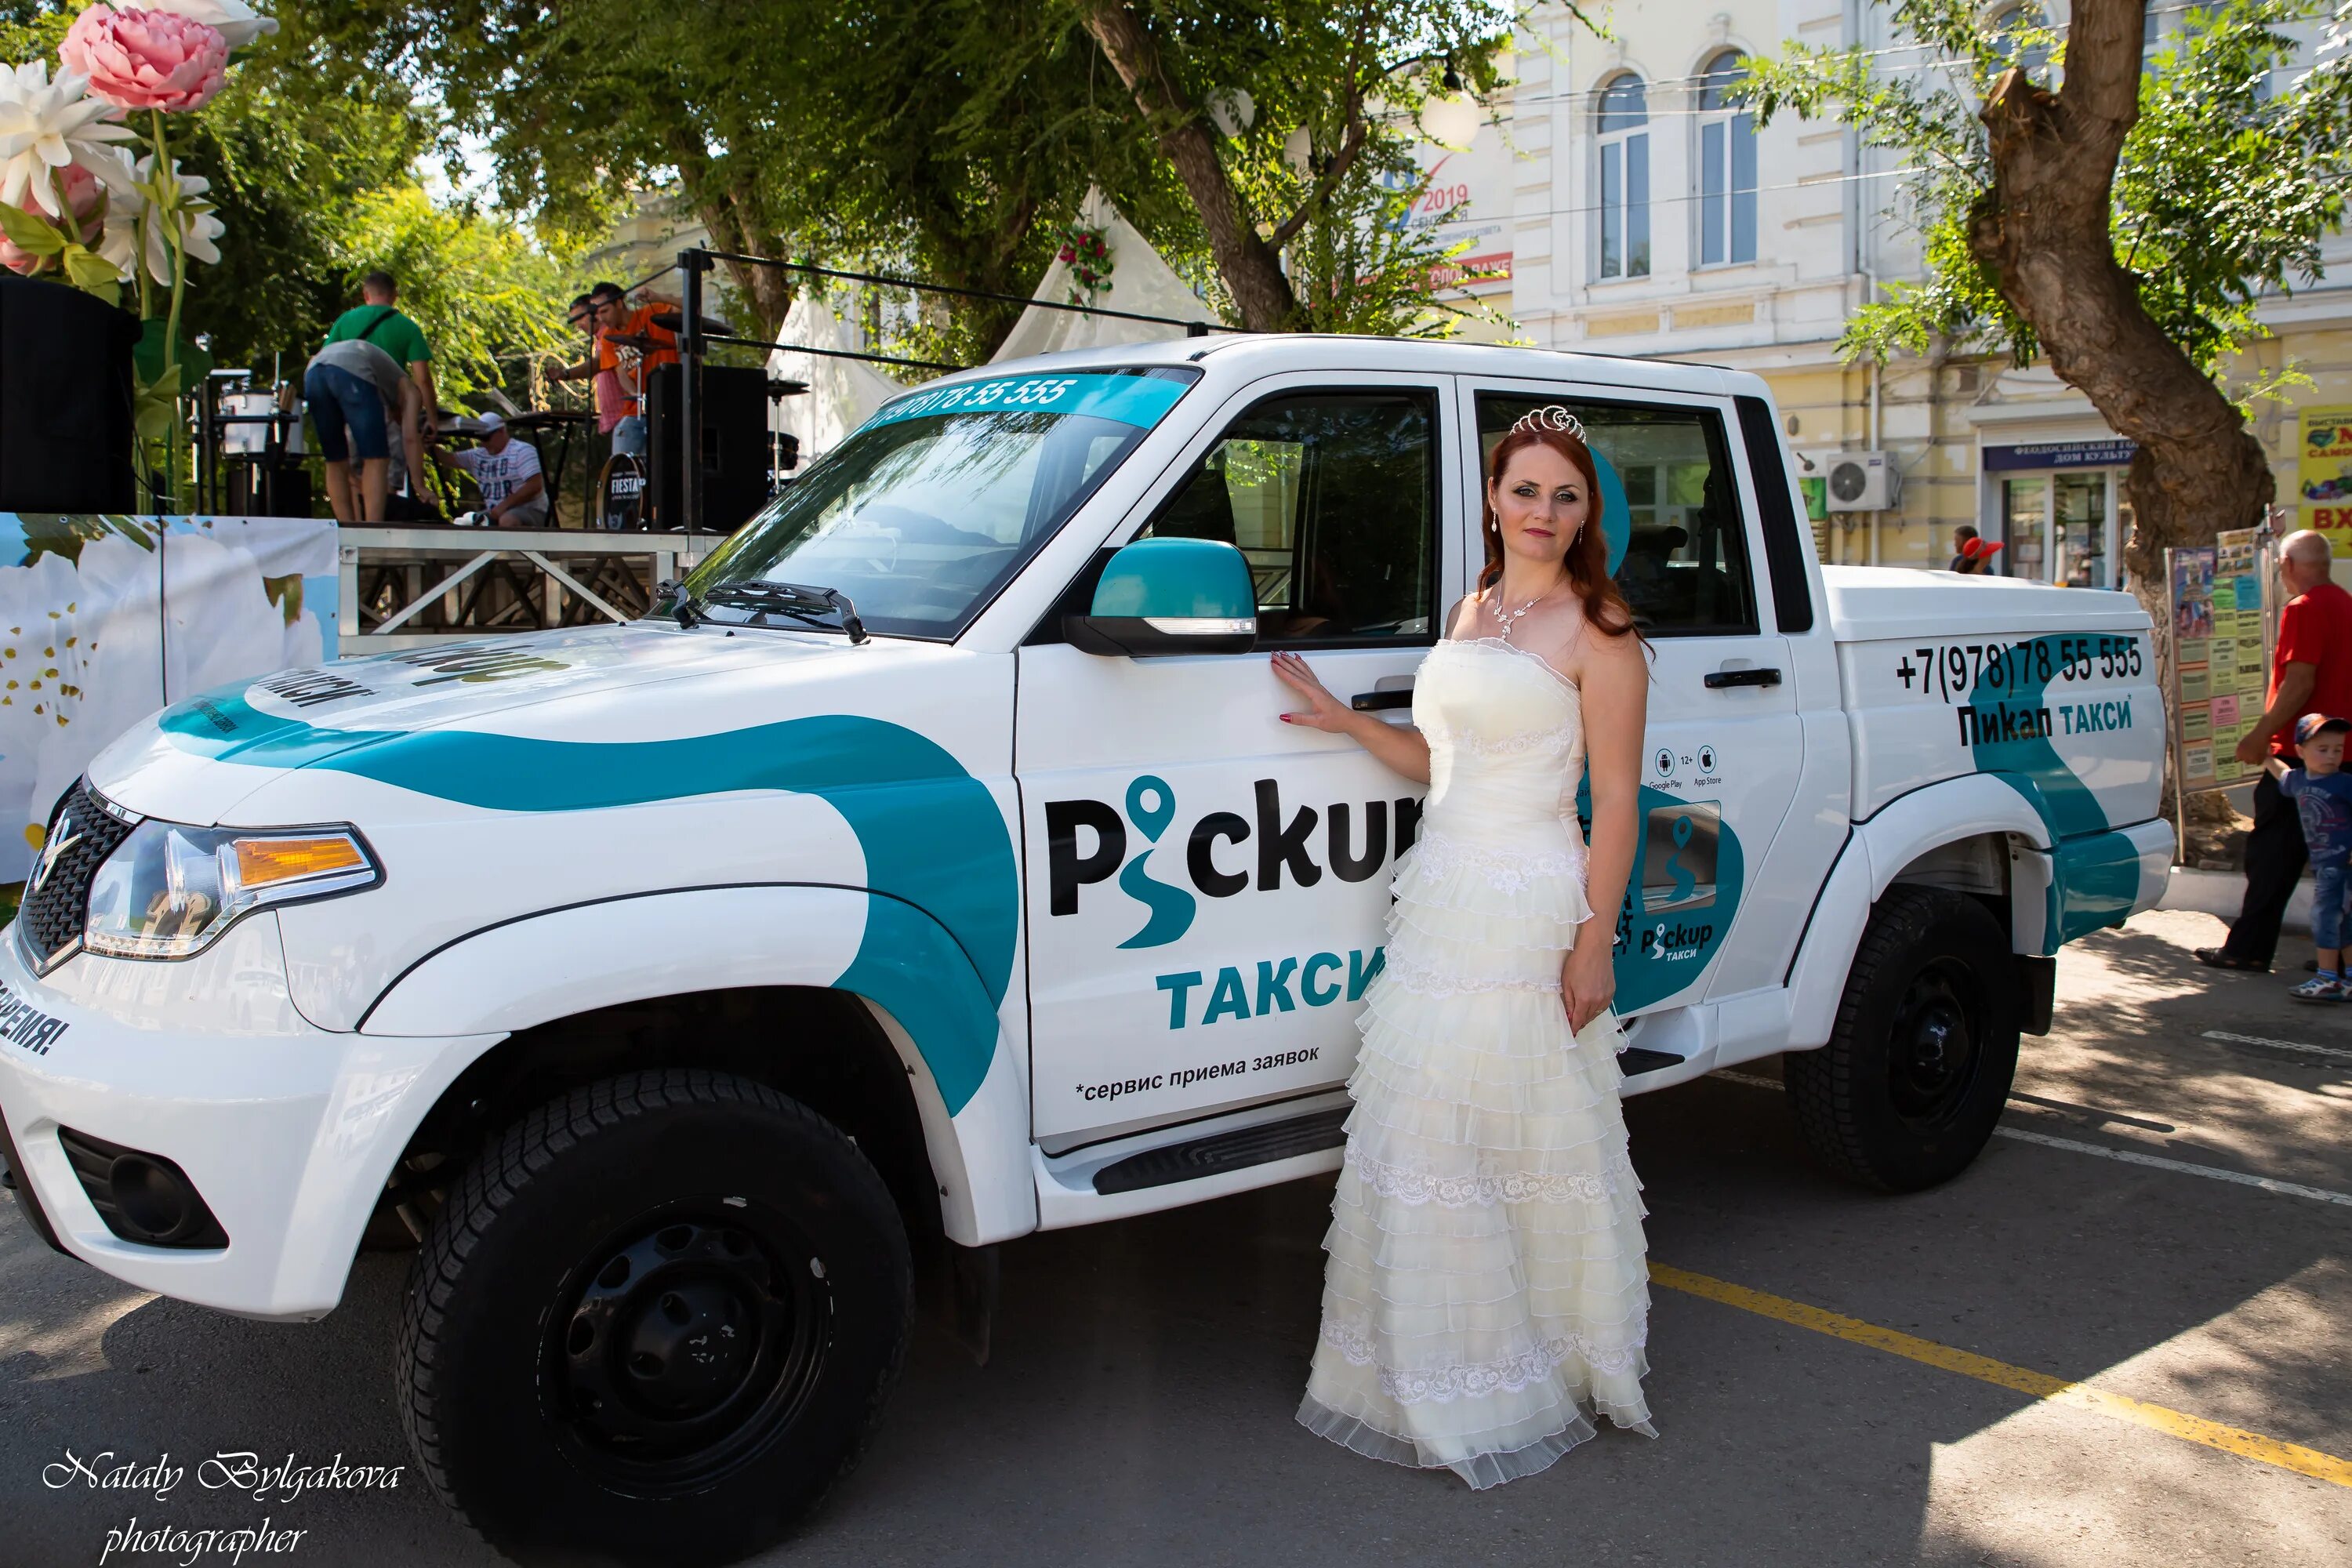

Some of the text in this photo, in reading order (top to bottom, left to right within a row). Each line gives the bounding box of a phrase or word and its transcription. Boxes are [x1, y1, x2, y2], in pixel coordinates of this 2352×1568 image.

[1423, 184, 1468, 212] 2019
[1411, 209, 1468, 230] СЕНТЯ
[964, 382, 1015, 406] 55
[1004, 379, 1079, 405] 555
[612, 477, 639, 494] FIESTA
[2060, 639, 2092, 681] 55
[2100, 637, 2142, 680] 555
[1957, 701, 2053, 746] Пикап
[1680, 756, 1693, 766] 12+
[1649, 779, 1682, 791] Google Play
[1693, 776, 1722, 786] App Store
[1666, 948, 1697, 962] ТАКСИ
[1169, 1058, 1247, 1088] приема
[1252, 1046, 1319, 1072] заявок
